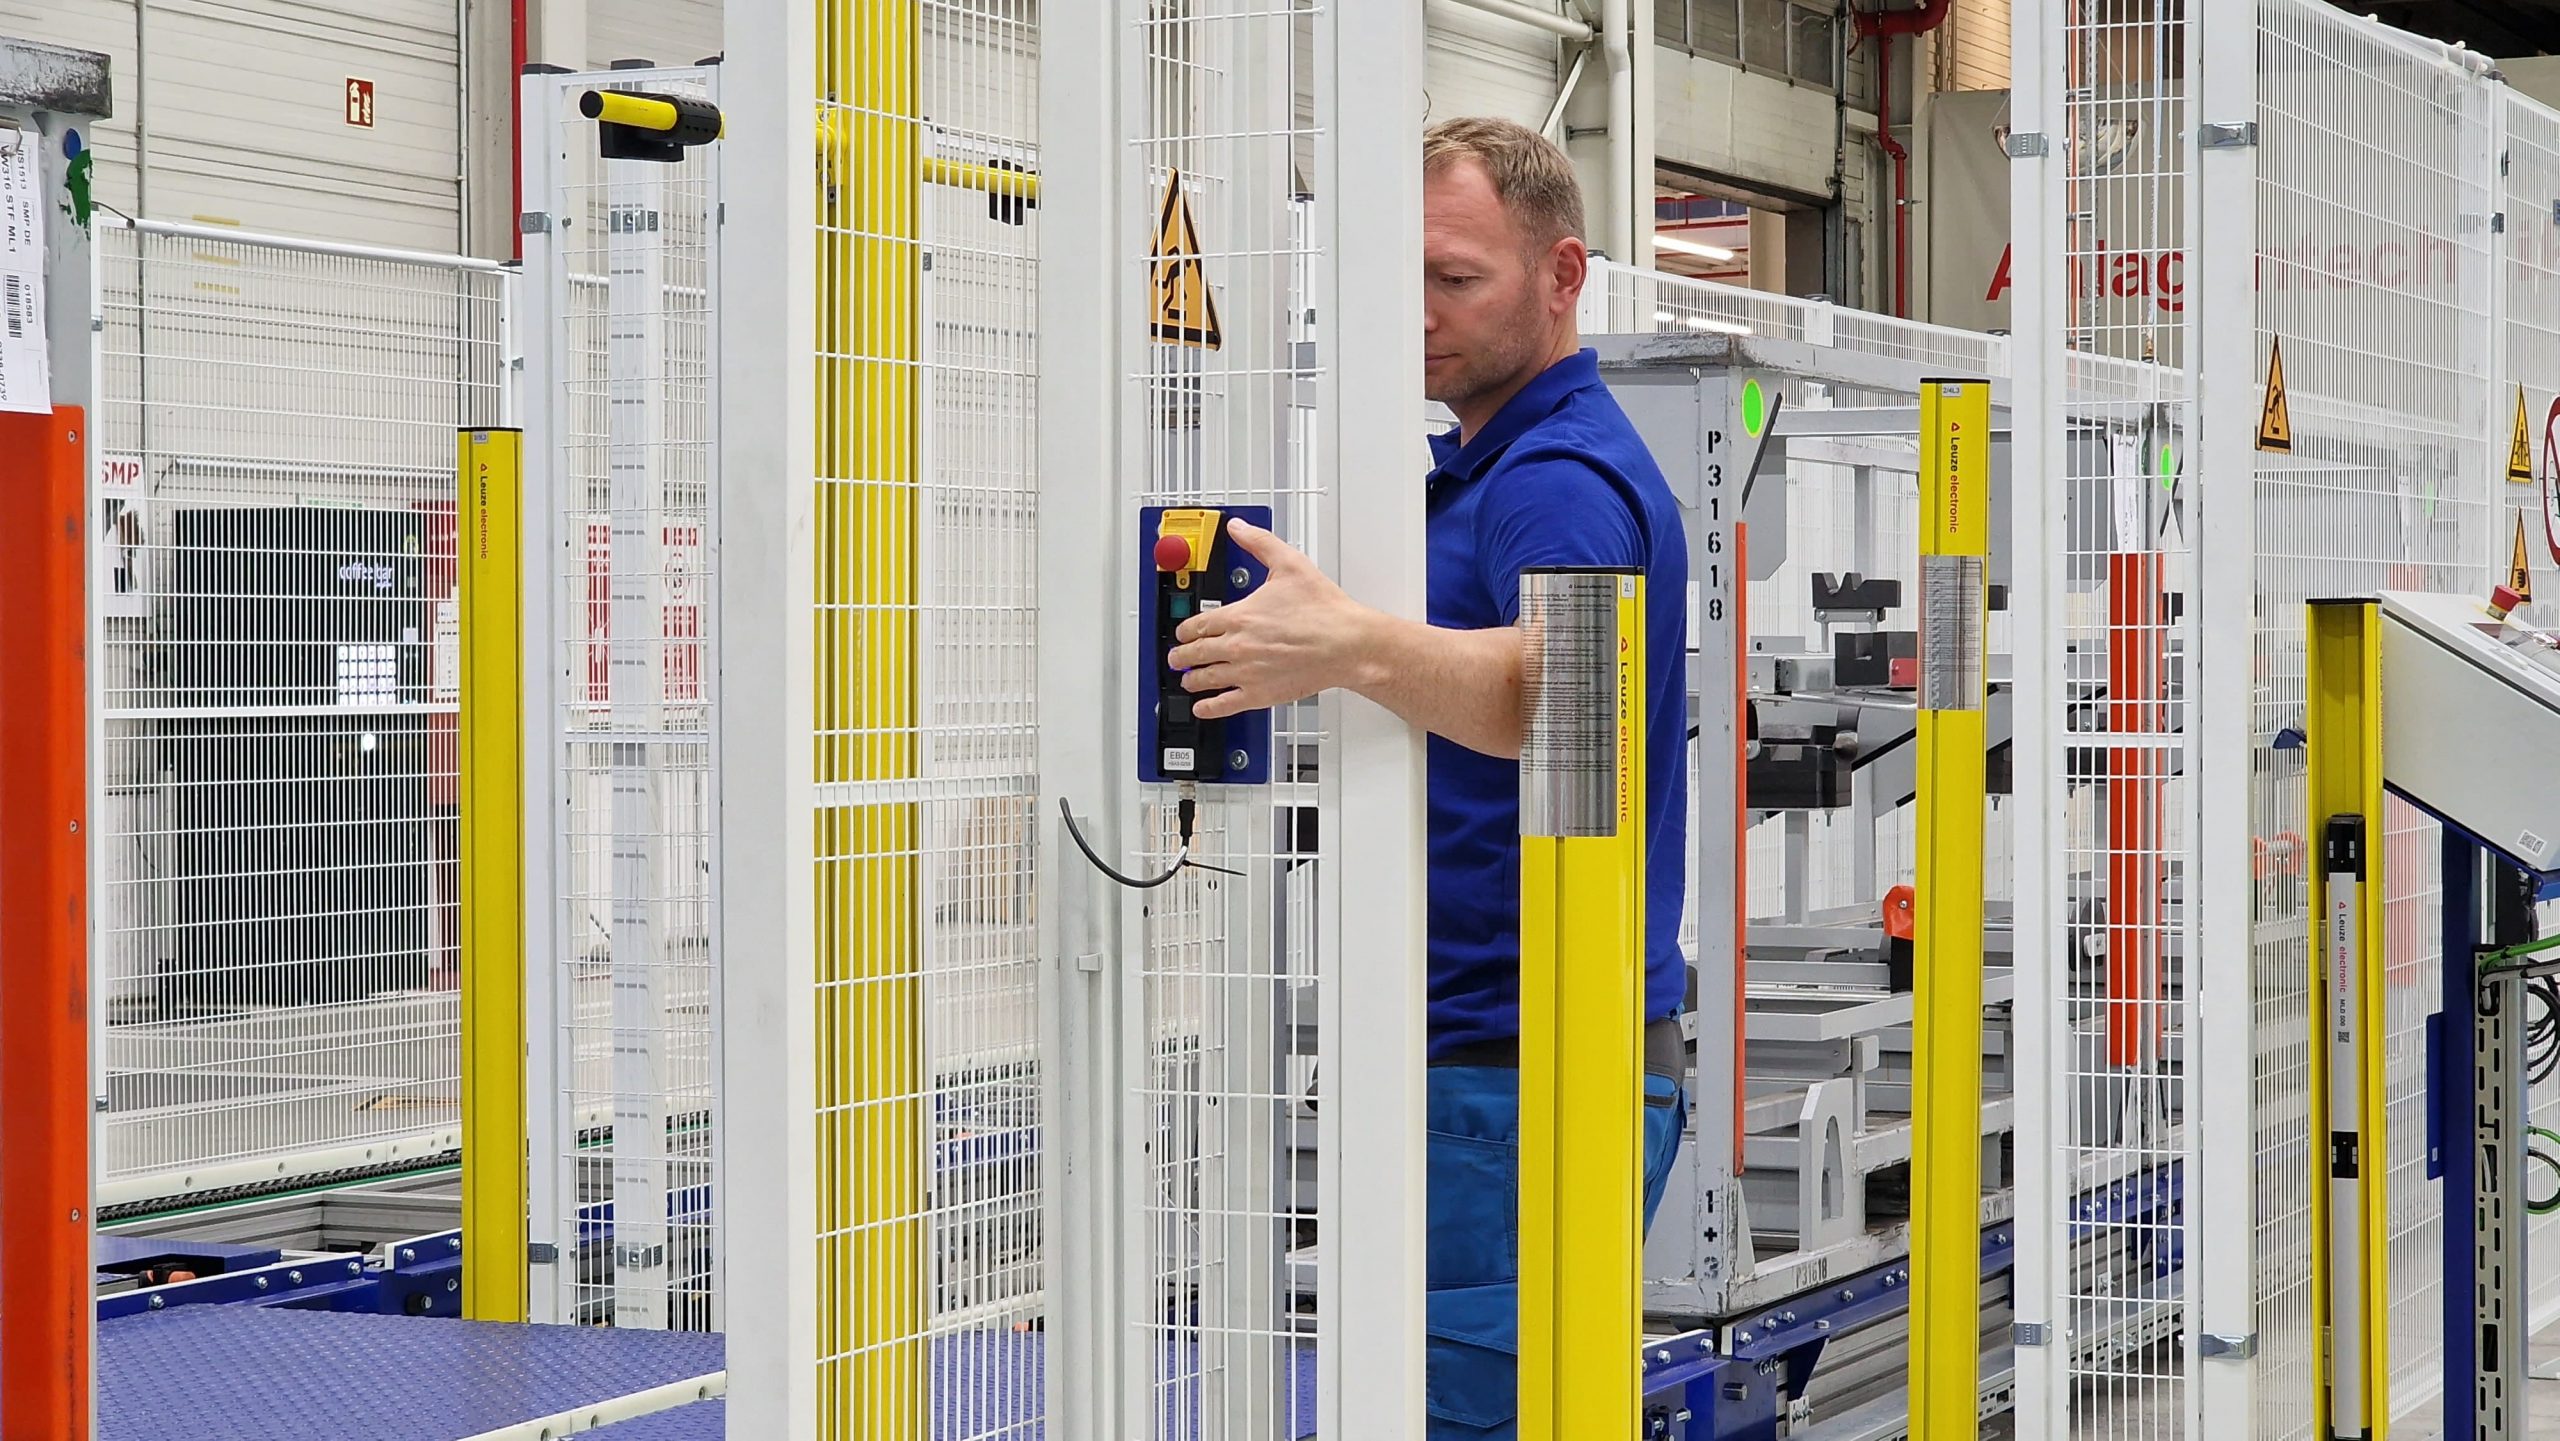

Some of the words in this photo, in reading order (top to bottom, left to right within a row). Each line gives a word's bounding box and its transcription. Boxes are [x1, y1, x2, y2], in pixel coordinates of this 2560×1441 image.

[5, 194, 15, 221] STF
[22, 200, 31, 227] SMP
[24, 229, 31, 246] DE
[1950, 437, 1960, 472] Leuze
[480, 475, 488, 507] Leuze
[1950, 474, 1960, 533] electronic
[480, 508, 488, 560] electronic
[1169, 751, 1190, 760] EB05
[2338, 913, 2347, 942] Leuze
[2338, 946, 2348, 993] electronic
